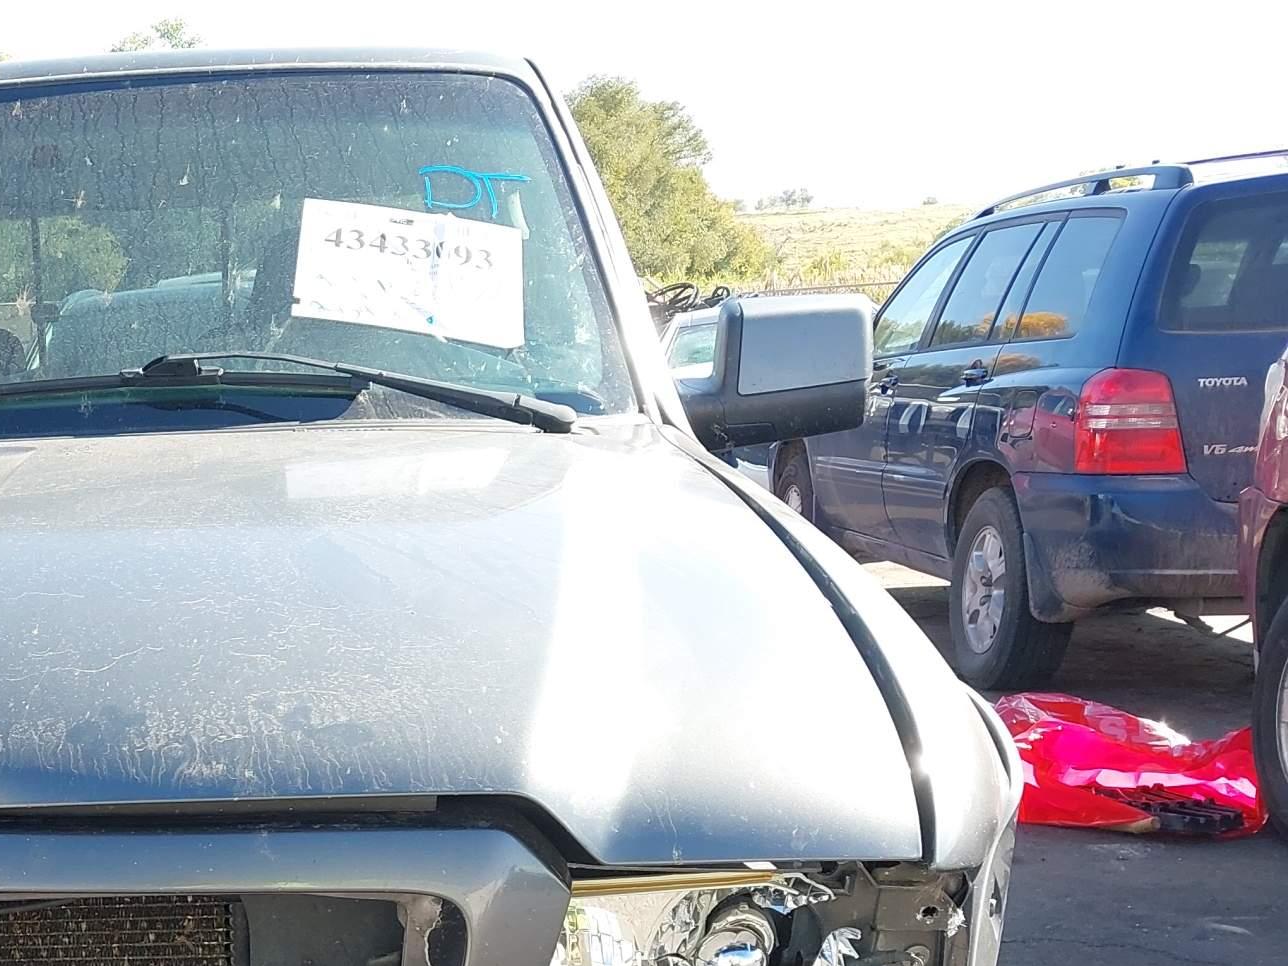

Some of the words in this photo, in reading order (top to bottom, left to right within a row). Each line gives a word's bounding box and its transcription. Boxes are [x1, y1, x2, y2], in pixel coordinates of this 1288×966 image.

[418, 164, 531, 218] DT
[1197, 376, 1249, 388] TOYOTA
[1203, 444, 1228, 455] V6
